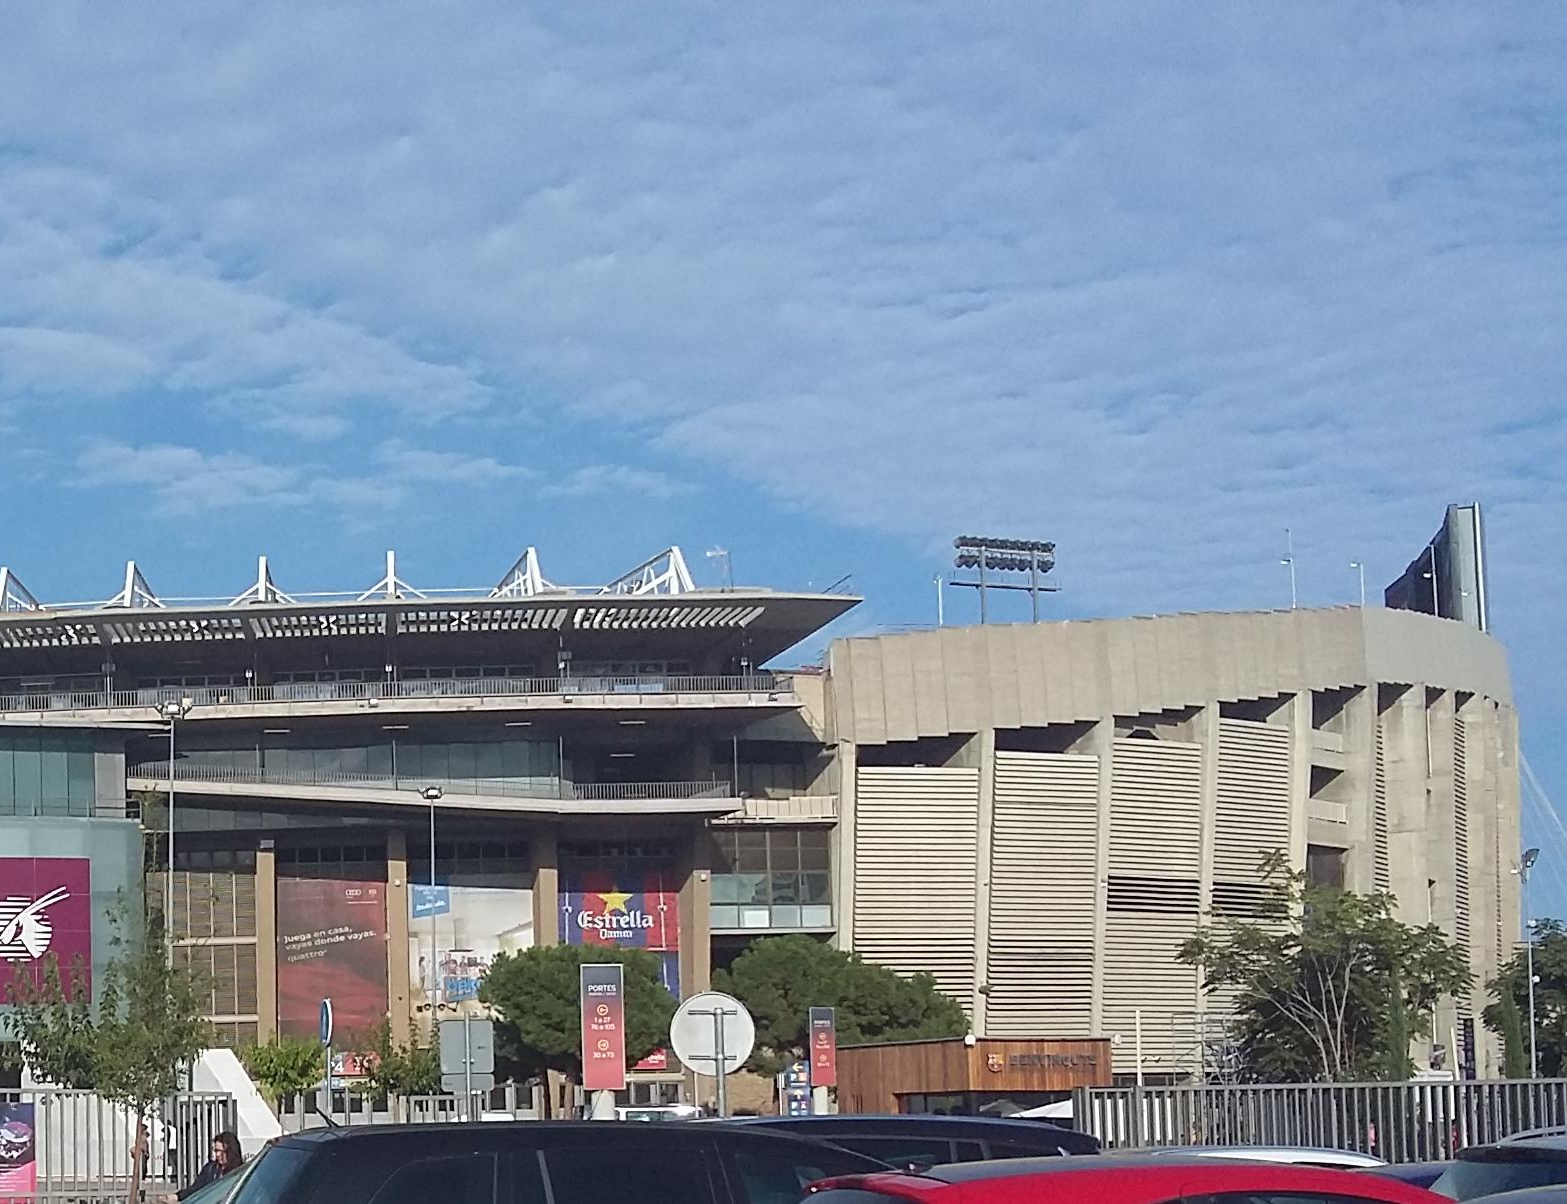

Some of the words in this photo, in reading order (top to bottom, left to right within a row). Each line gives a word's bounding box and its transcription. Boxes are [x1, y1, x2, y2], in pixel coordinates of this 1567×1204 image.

[577, 910, 654, 929] Estrella
[284, 933, 312, 943] Juega
[313, 930, 326, 938] en
[327, 926, 353, 935] casa,
[285, 940, 312, 951] vayas
[314, 933, 345, 946] donde
[347, 930, 377, 941] vayas.
[599, 928, 633, 939] Damm
[588, 984, 616, 992] PORTES
